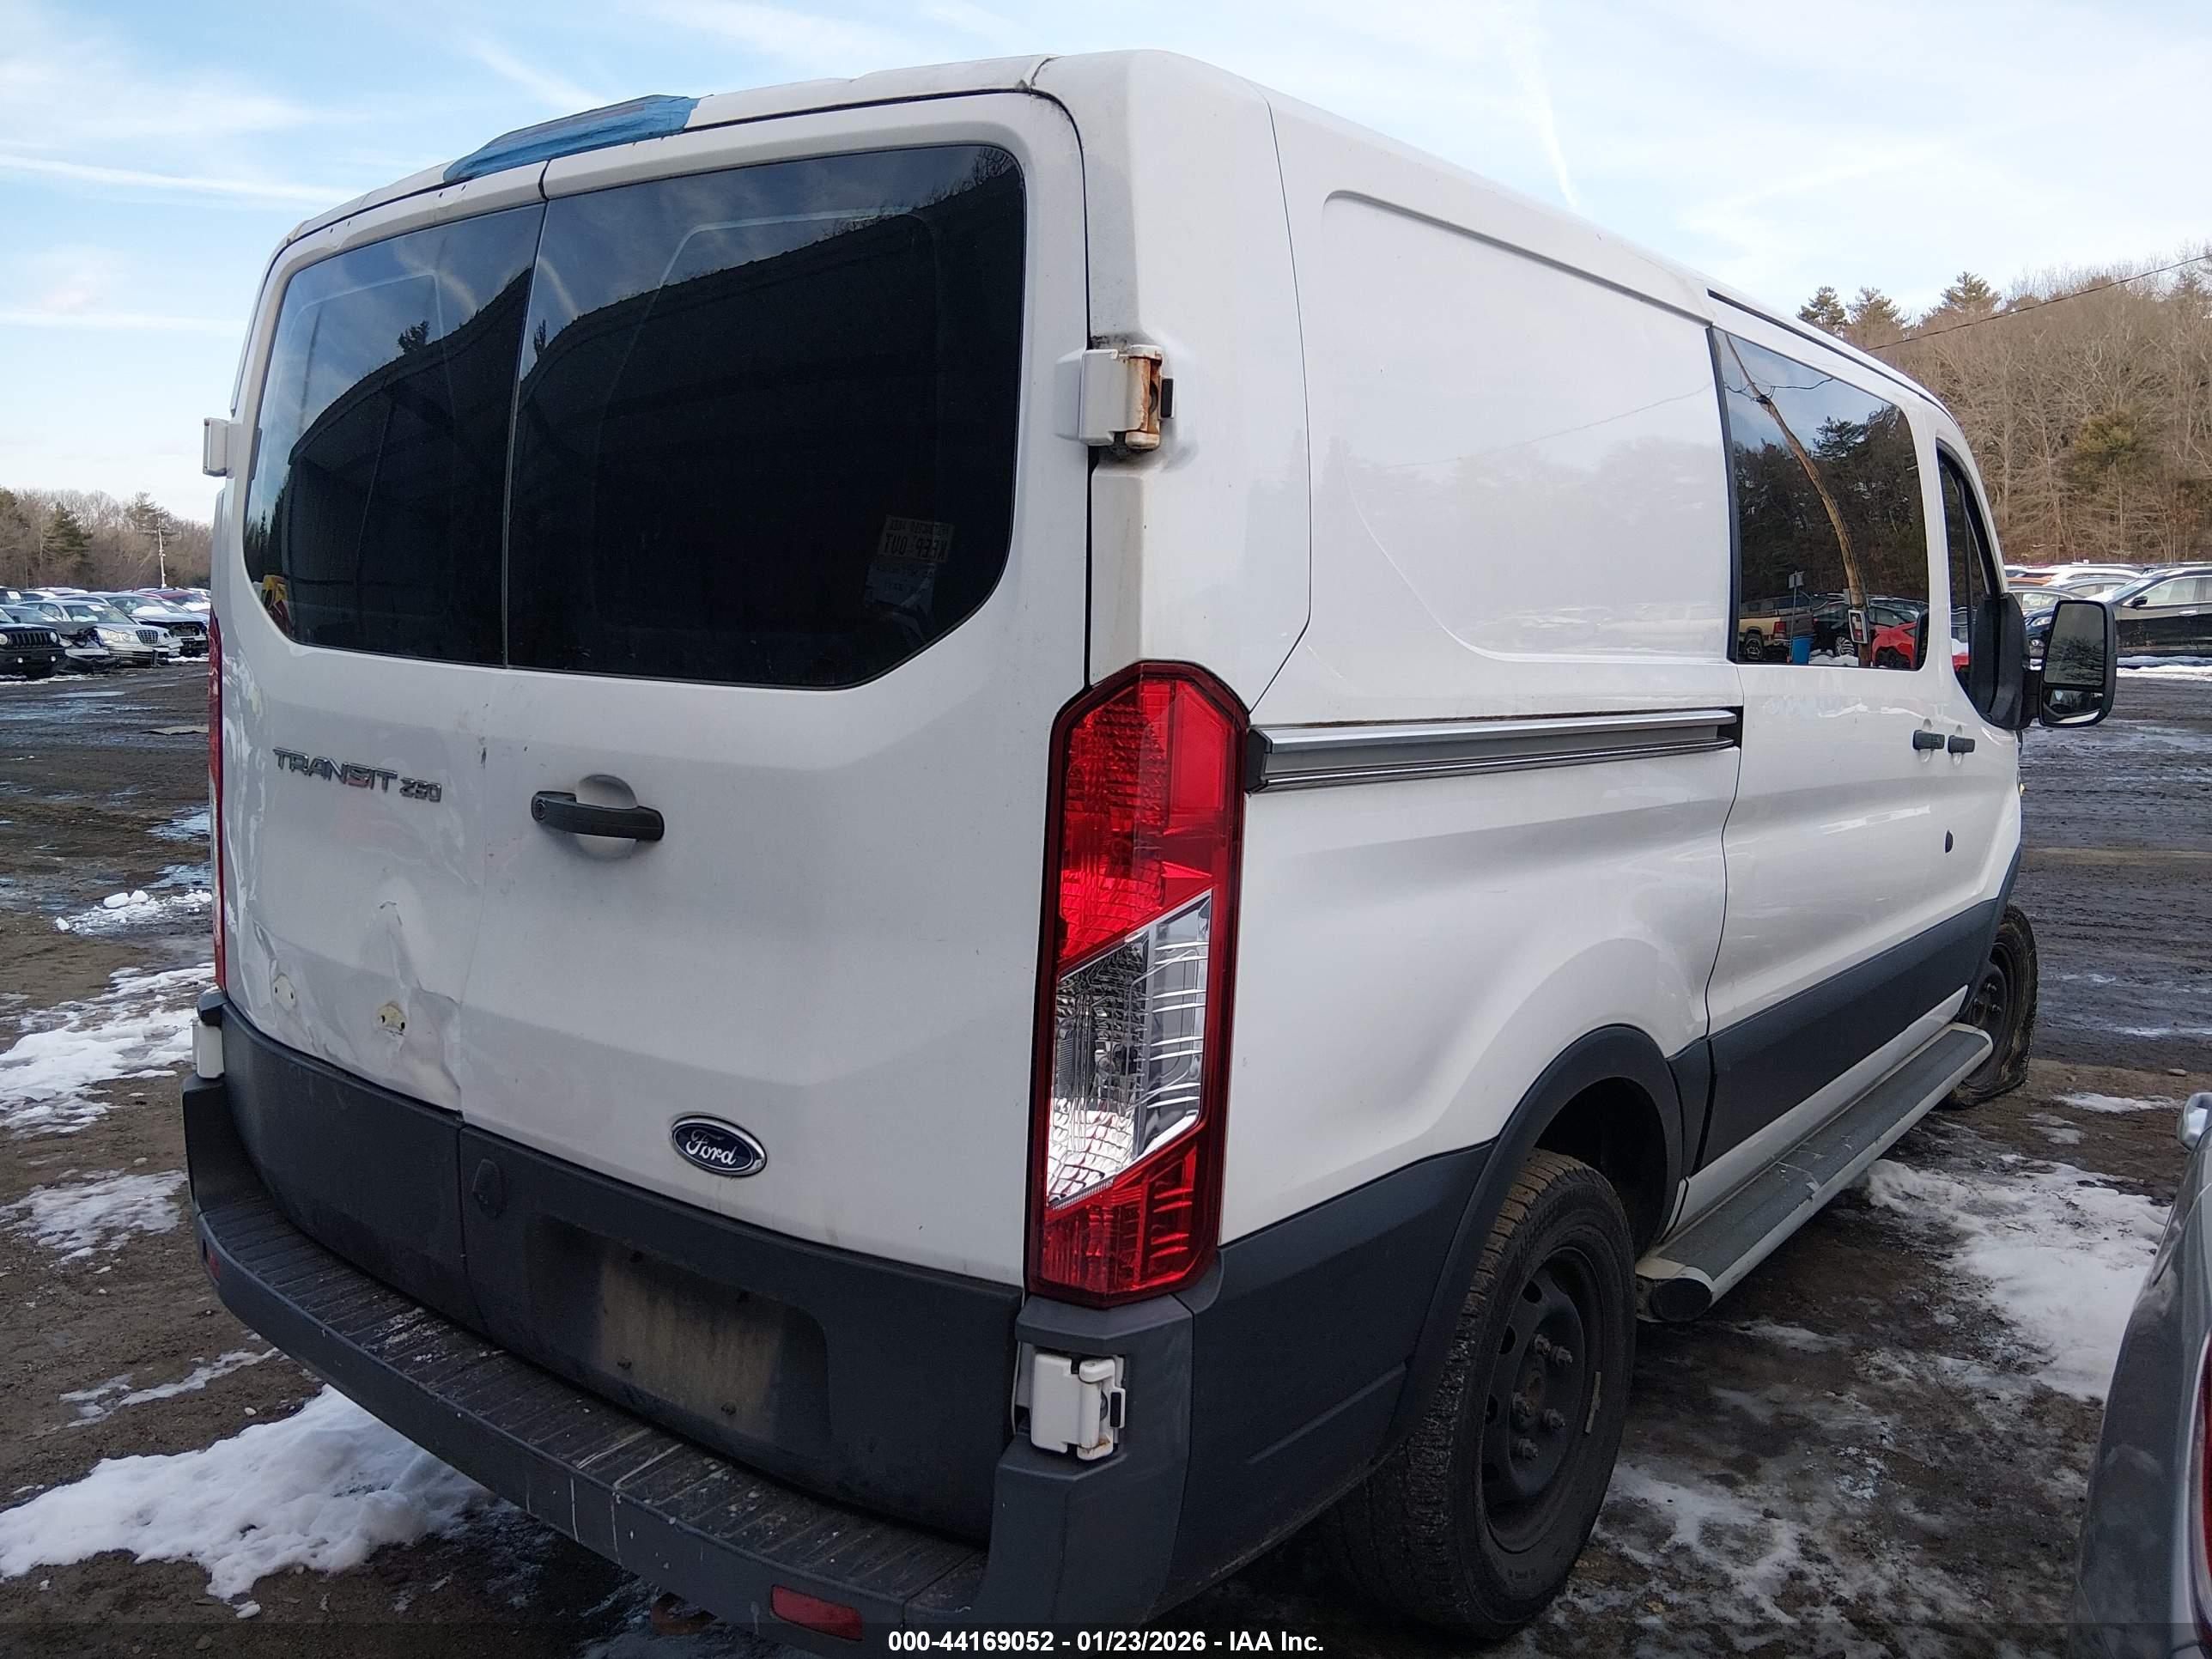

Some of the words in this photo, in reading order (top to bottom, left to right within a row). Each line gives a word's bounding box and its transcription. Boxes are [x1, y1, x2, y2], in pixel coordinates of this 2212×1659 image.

[272, 746, 398, 793] TRANSIT
[398, 776, 442, 804] 250
[685, 1128, 738, 1165] Ford
